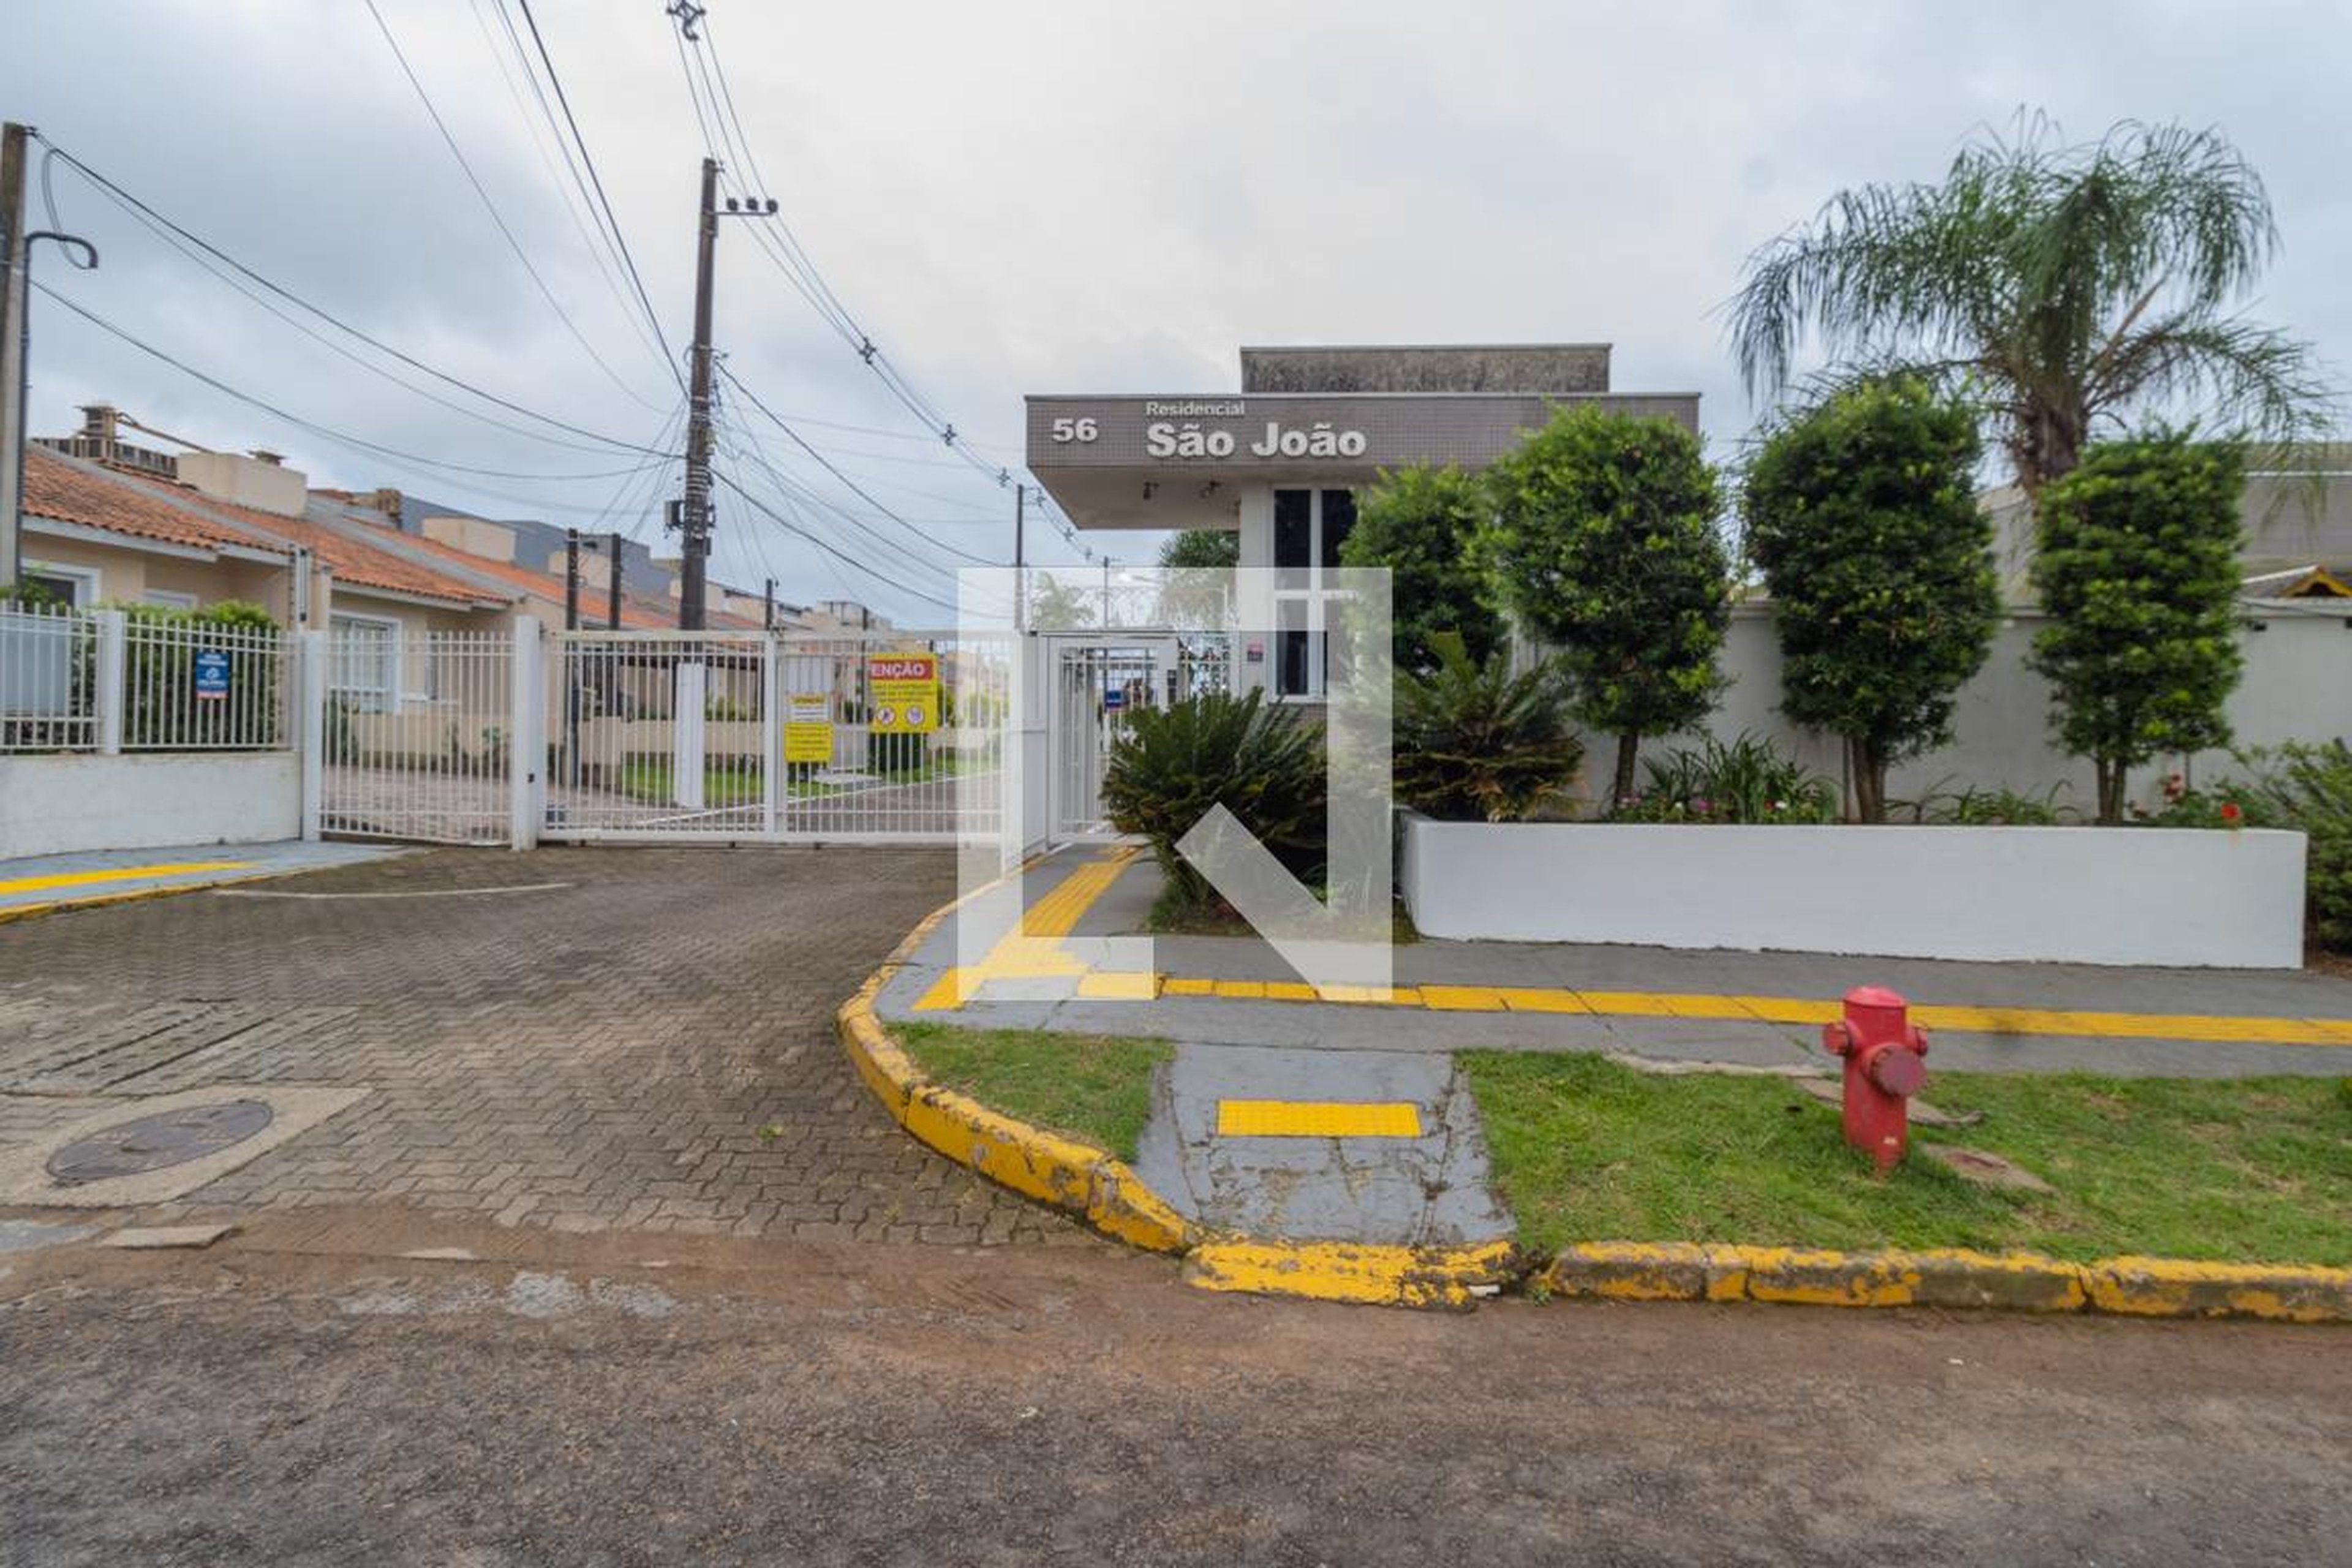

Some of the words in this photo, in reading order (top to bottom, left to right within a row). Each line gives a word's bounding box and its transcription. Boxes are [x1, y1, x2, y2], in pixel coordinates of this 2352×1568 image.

[1146, 401, 1245, 416] Residencial
[1052, 417, 1098, 442] 56
[1147, 422, 1234, 457] São
[1251, 421, 1366, 457] João
